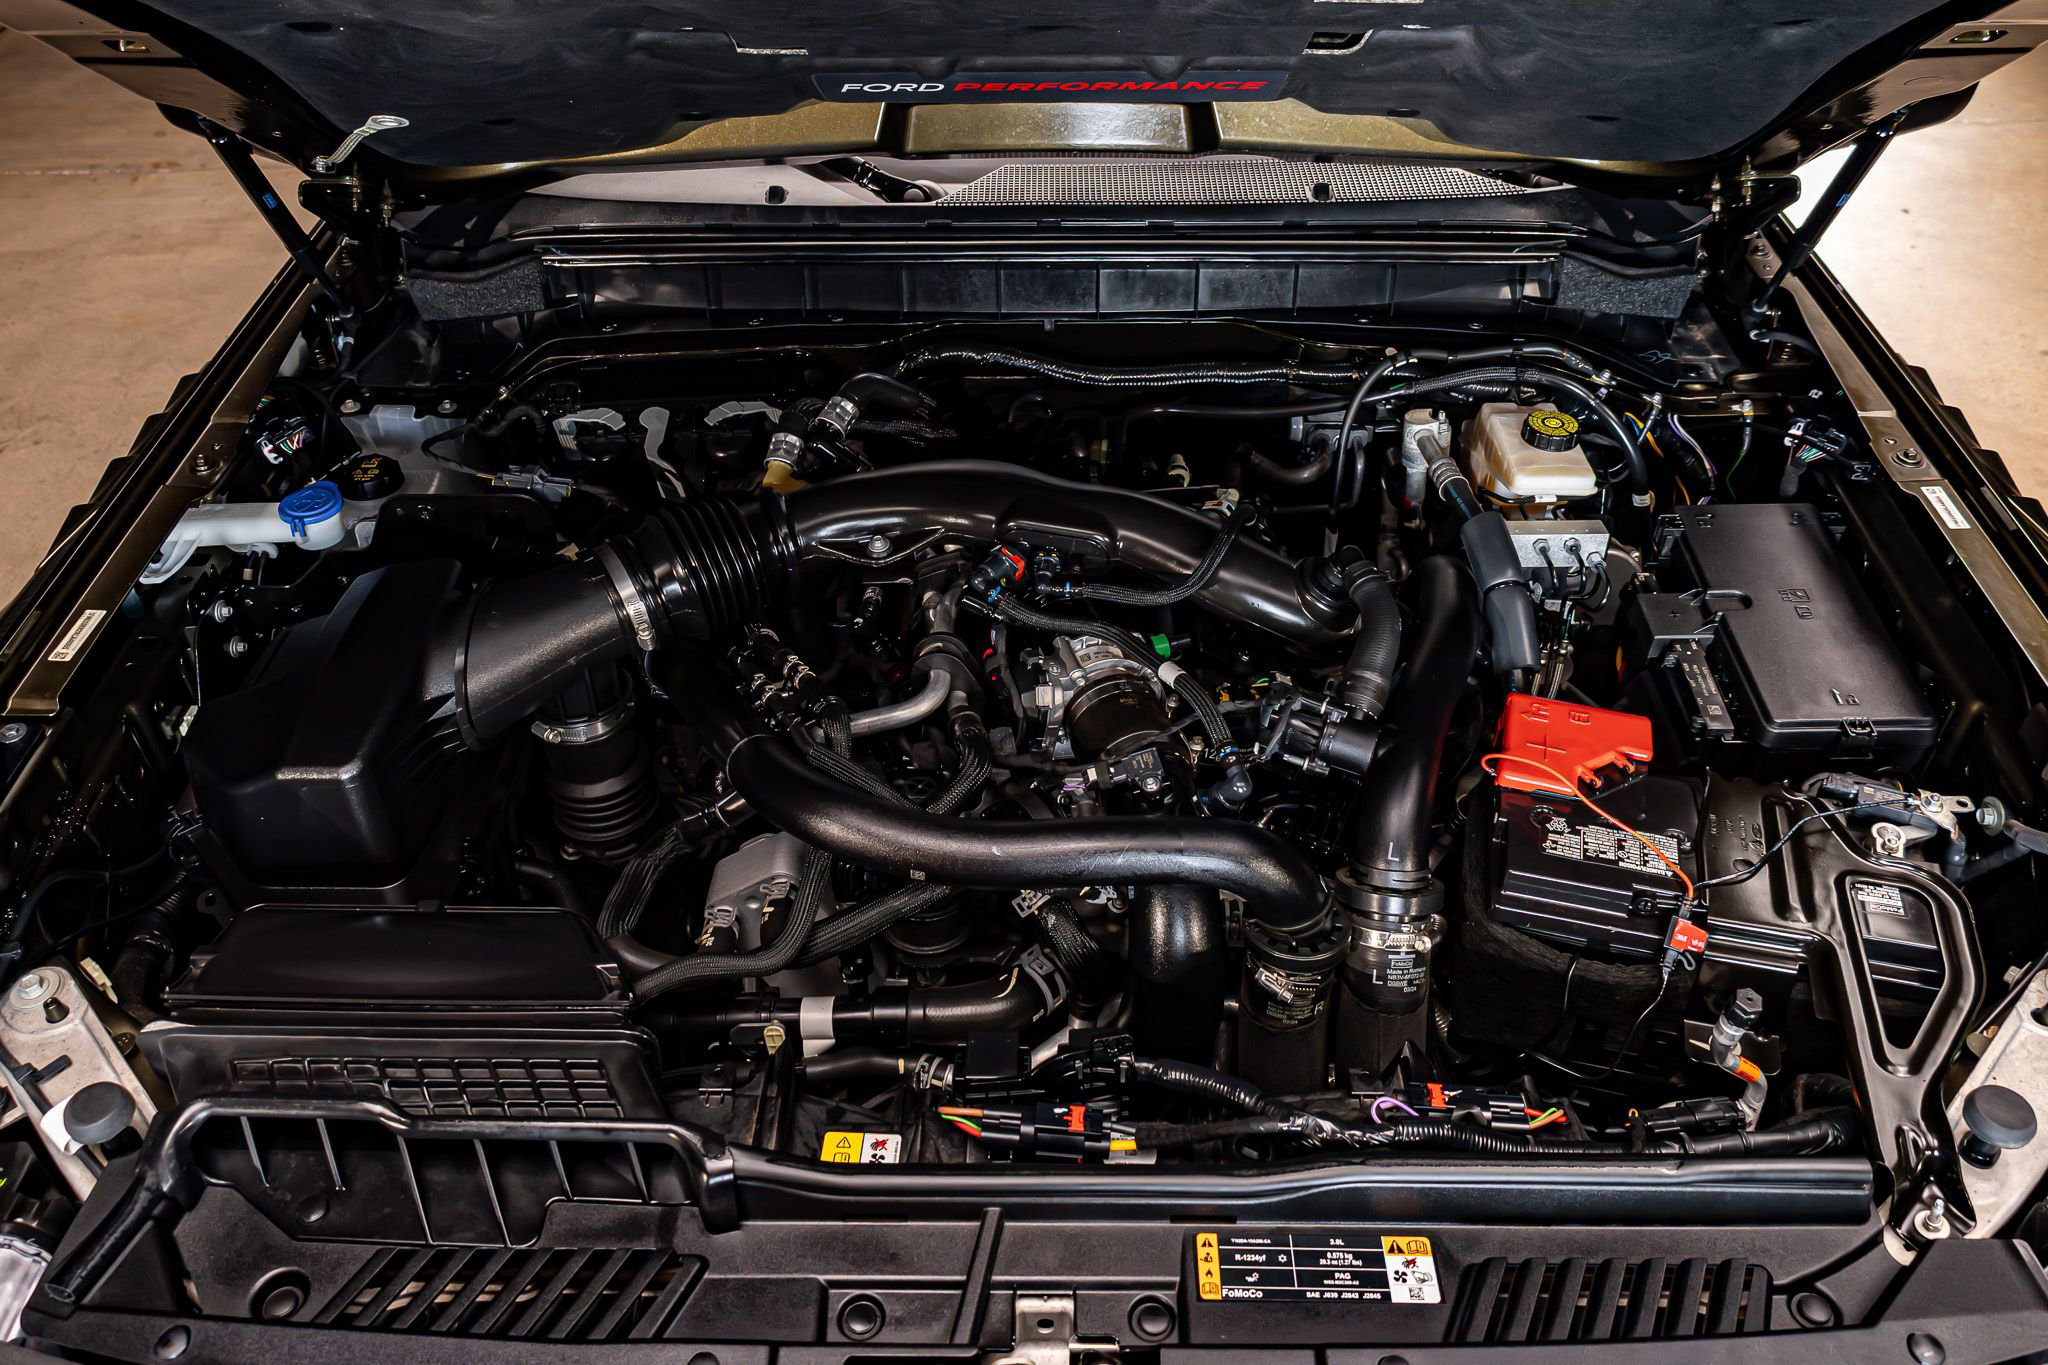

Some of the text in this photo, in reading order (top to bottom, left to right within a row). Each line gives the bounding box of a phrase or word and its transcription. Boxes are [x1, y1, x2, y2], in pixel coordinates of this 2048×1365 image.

[841, 81, 1269, 92] FORD PERFORMANCE
[1388, 842, 1399, 861] L
[1674, 933, 1688, 942] 3M
[1373, 969, 1383, 984] L
[1314, 1001, 1325, 1015] R
[1234, 1253, 1267, 1262] R-1234yf
[1345, 1252, 1353, 1260] kg
[1334, 1272, 1352, 1280] PAG
[1222, 1289, 1264, 1298] FoMoCo
